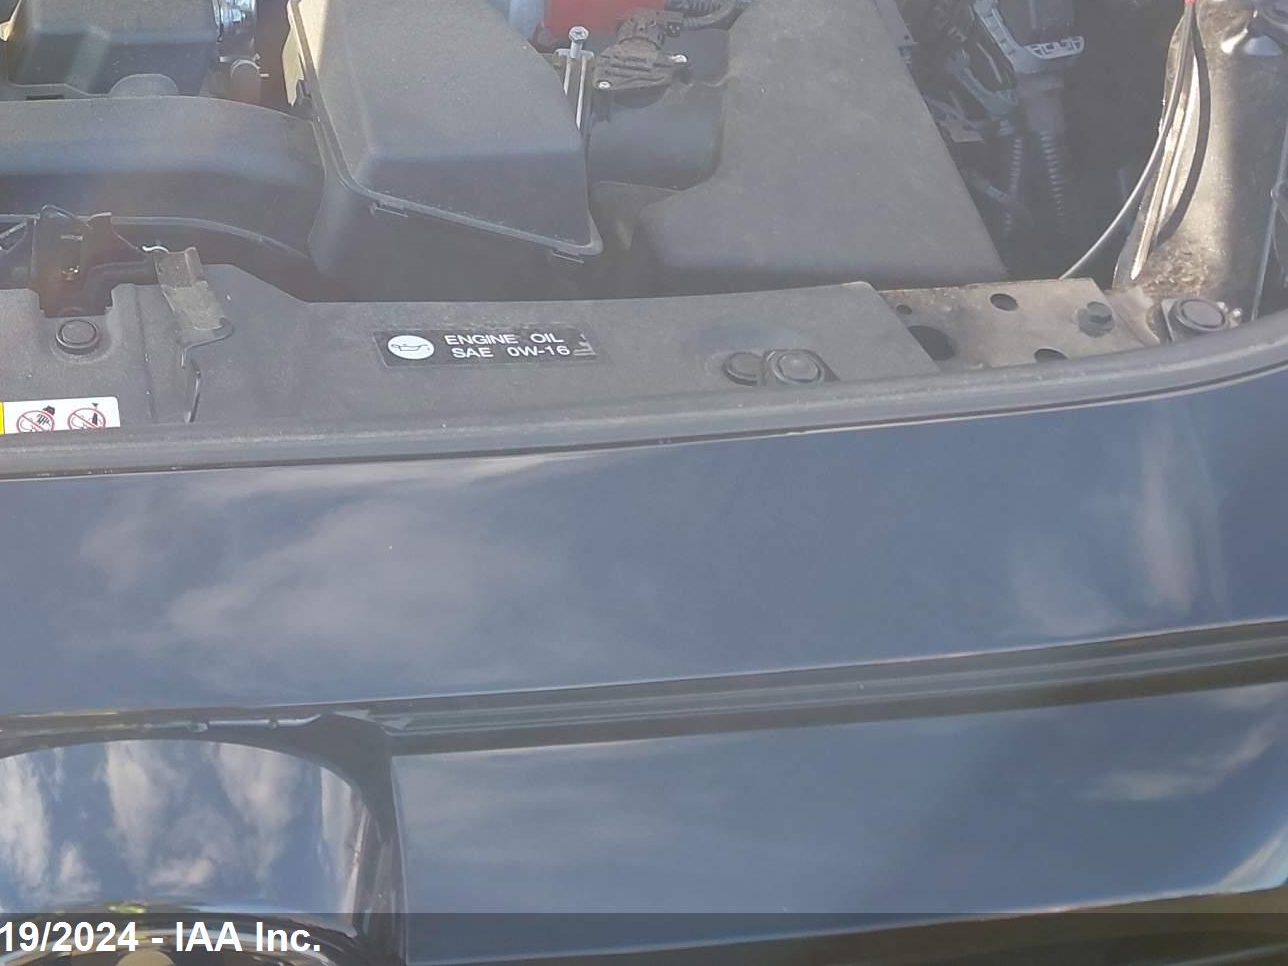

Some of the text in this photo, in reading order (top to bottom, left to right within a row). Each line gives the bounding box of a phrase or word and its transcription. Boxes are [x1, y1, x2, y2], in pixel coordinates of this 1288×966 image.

[444, 332, 565, 346] ENGINE OIL
[451, 345, 571, 359] SAE 0W-16
